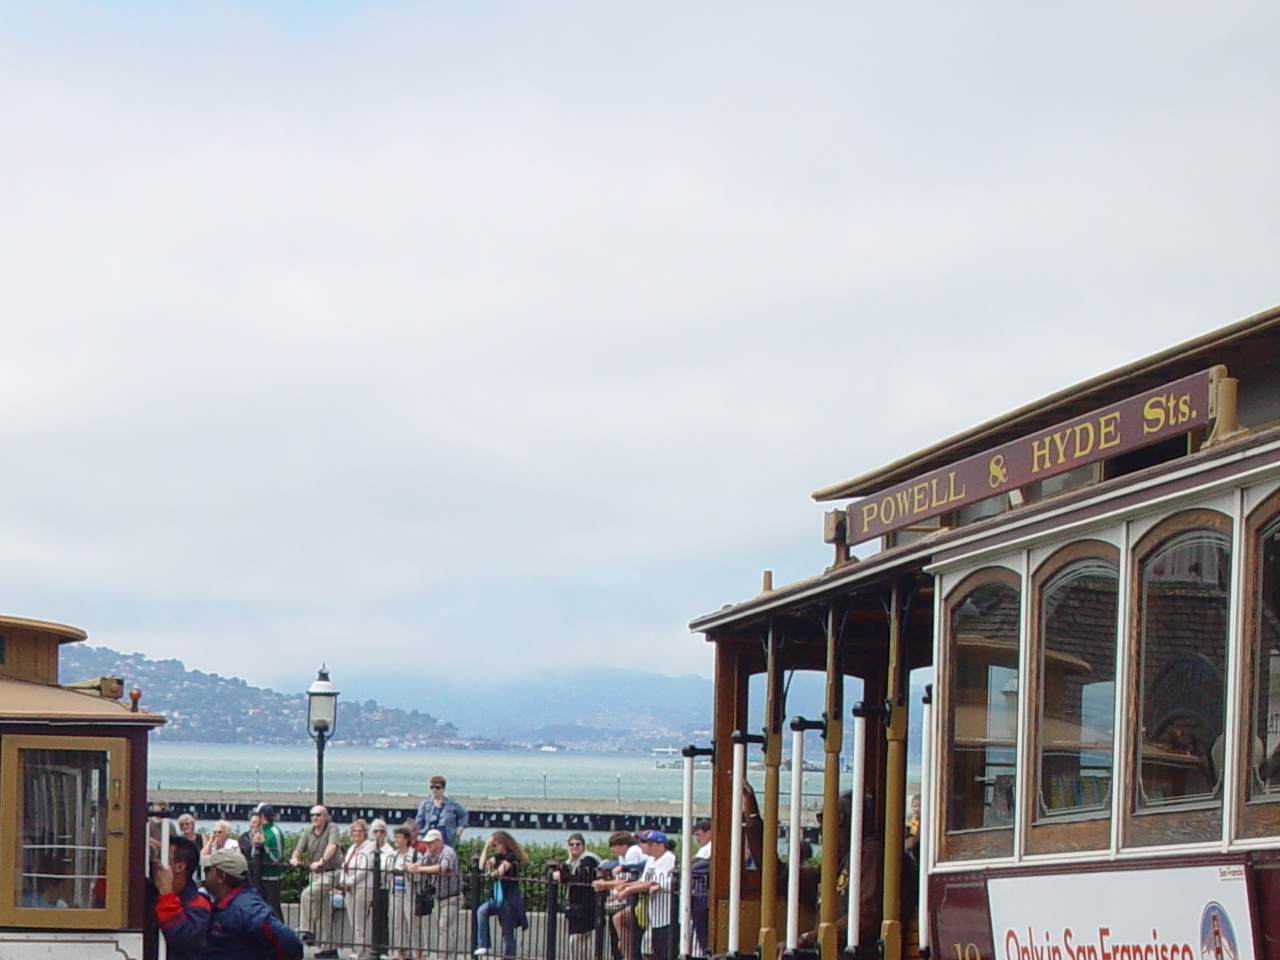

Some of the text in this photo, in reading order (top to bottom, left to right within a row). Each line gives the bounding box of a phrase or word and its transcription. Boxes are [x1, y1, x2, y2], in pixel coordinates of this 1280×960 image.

[861, 393, 1198, 533] POWELL & HYDE Sts.
